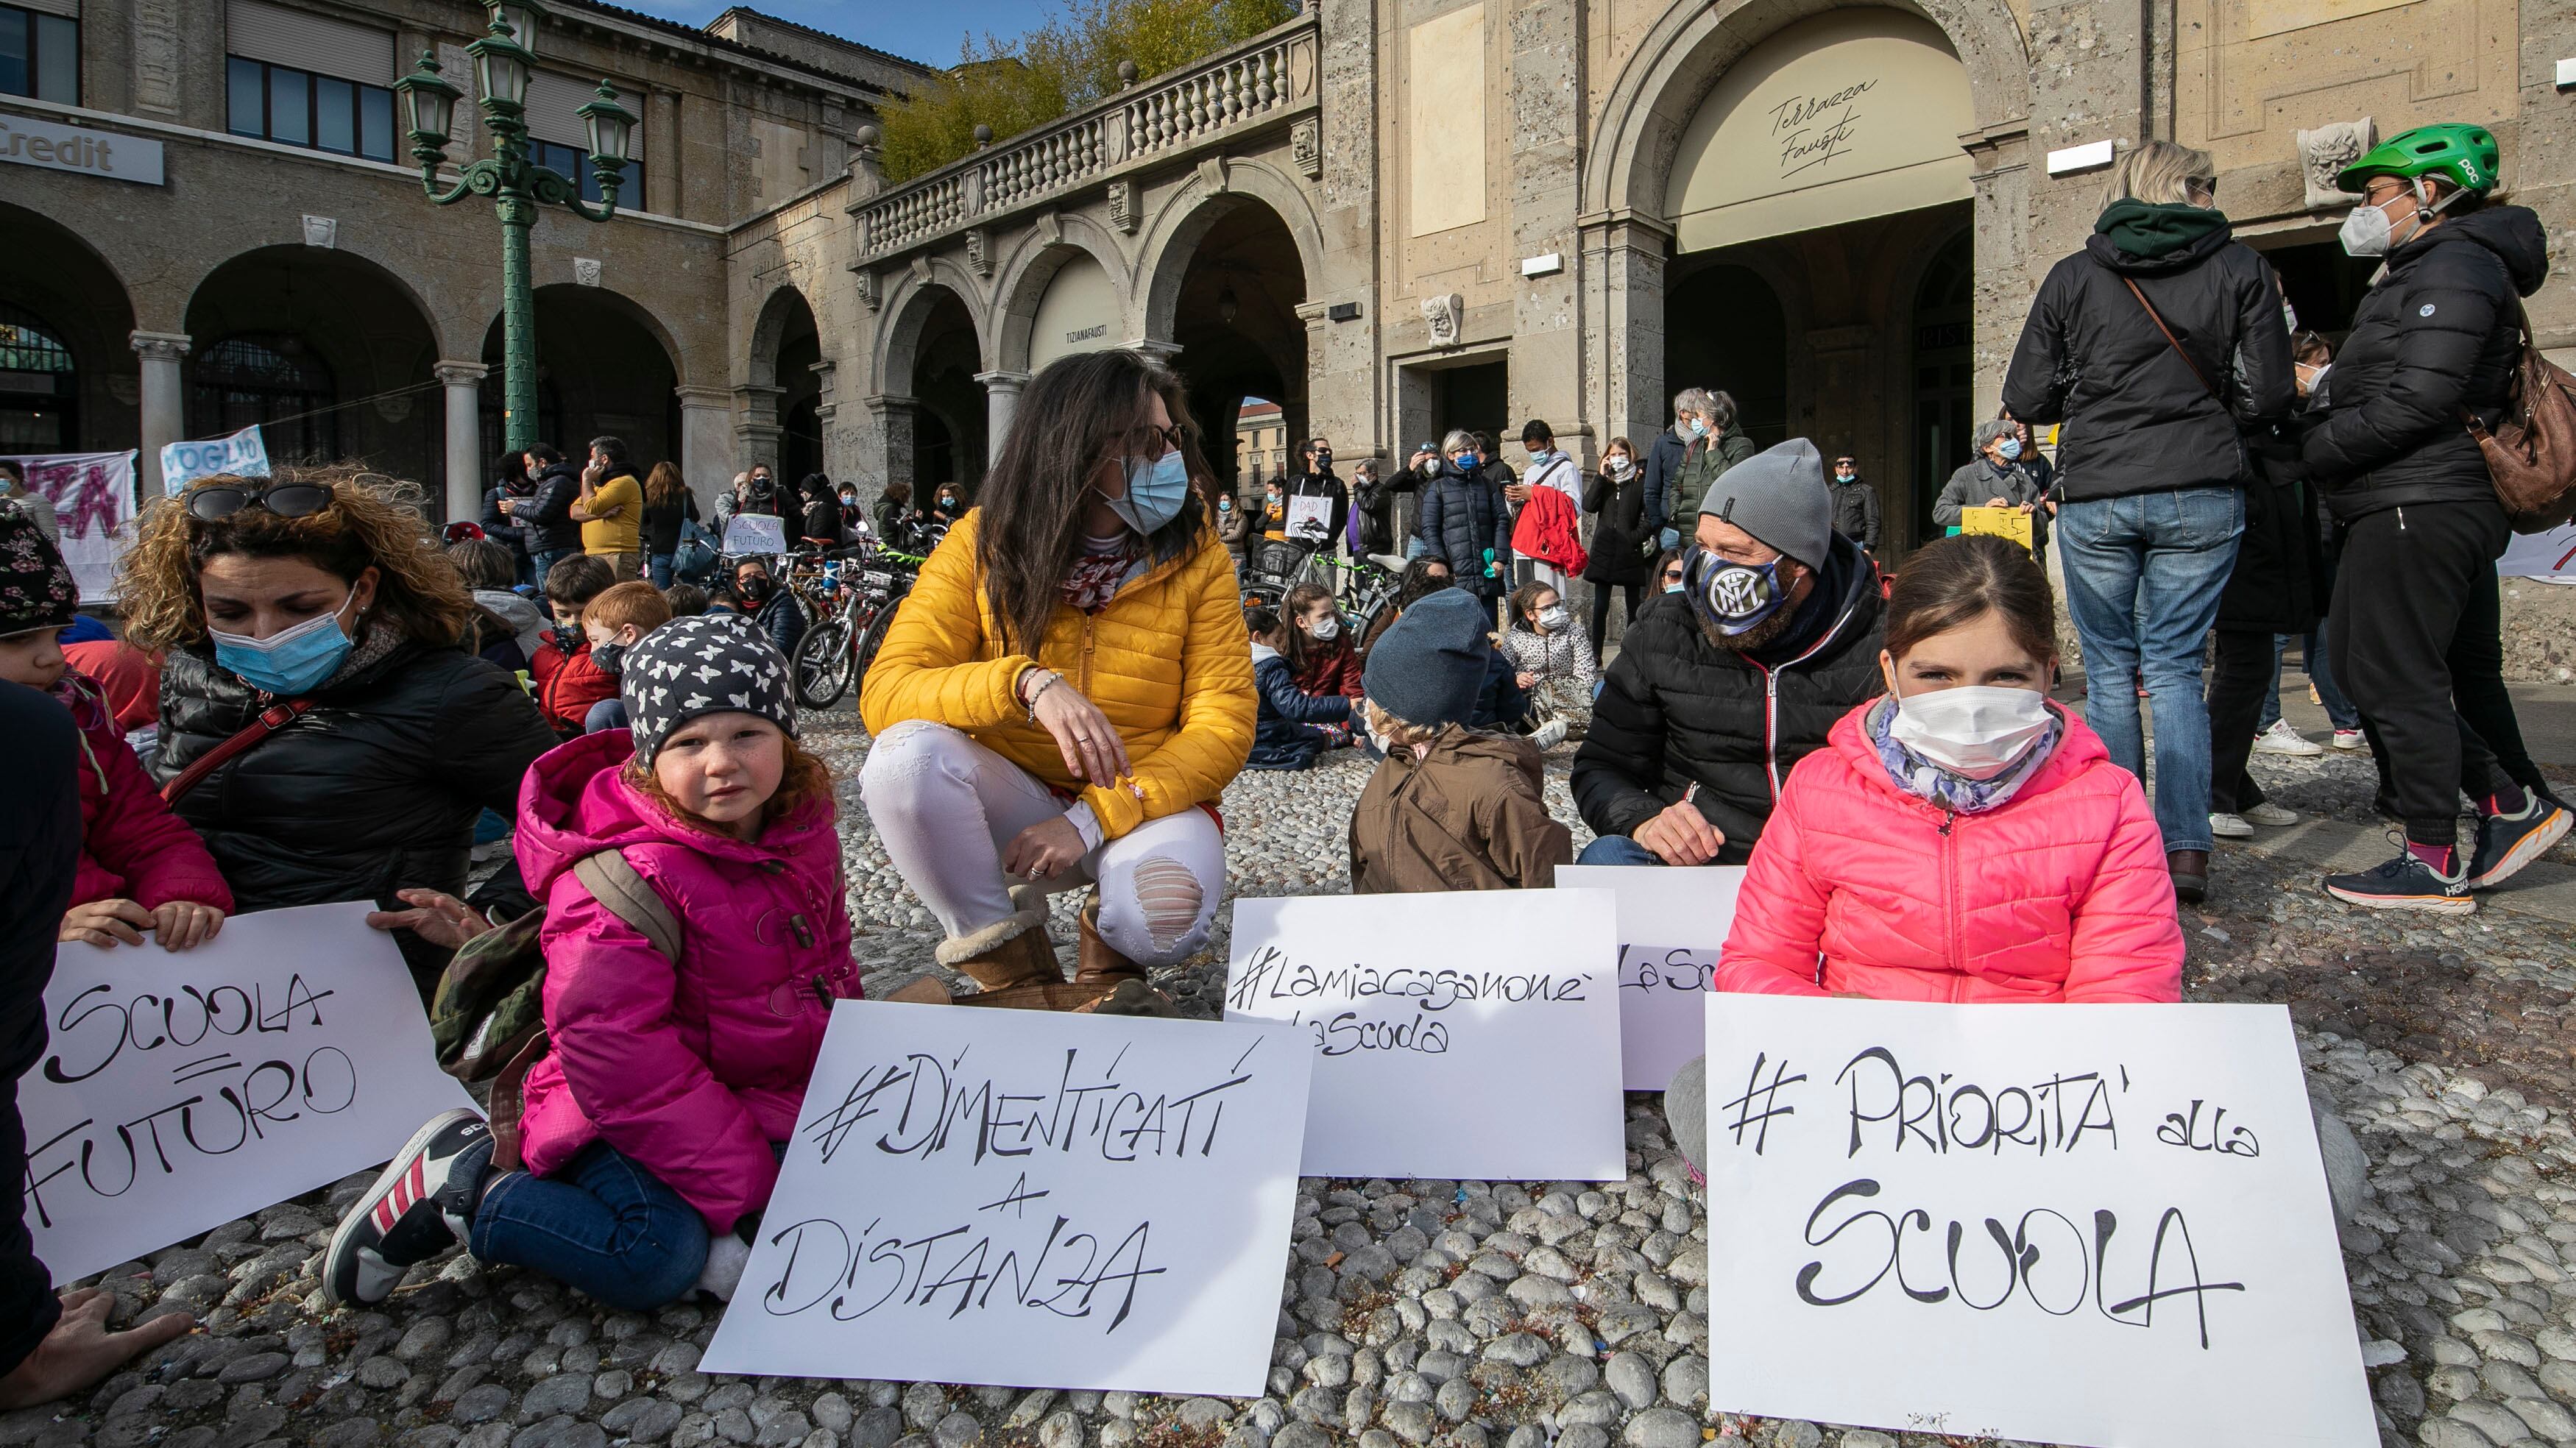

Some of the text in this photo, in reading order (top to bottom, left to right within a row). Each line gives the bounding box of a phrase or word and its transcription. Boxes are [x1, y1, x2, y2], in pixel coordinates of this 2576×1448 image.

[1768, 79, 1878, 136] Terrazza
[1781, 104, 1861, 167] Fausti
[1066, 324, 1107, 344] TIZIANAFAUSTI
[734, 519, 779, 531] SCUOLA
[1300, 500, 1318, 512] DAD
[733, 535, 774, 547] FUTURO
[2445, 878, 2469, 897] HOKA
[43, 973, 335, 1084] SCUOLA
[24, 1046, 357, 1228] FUTURO
[1795, 1178, 2246, 1351] SCUOLA
